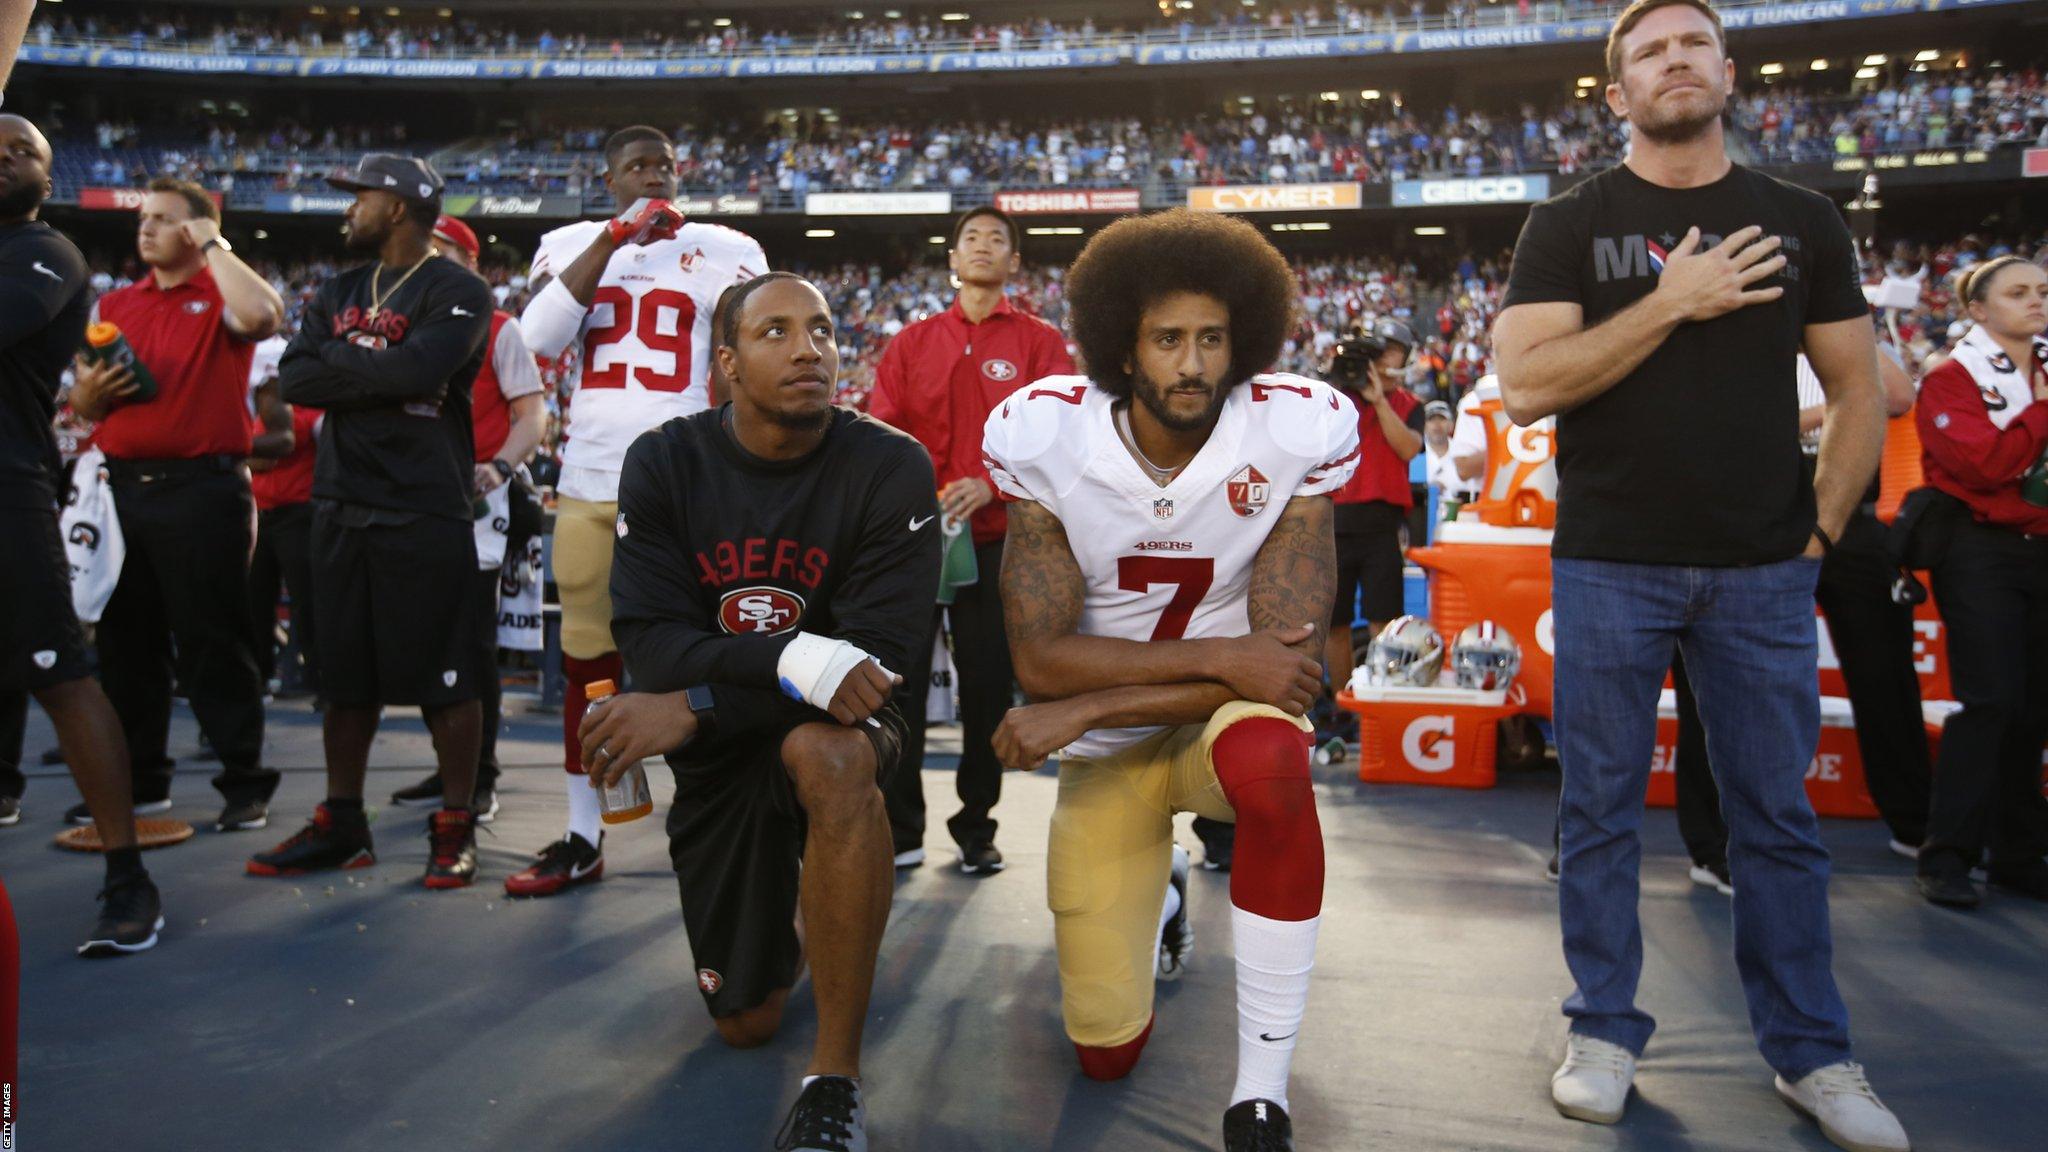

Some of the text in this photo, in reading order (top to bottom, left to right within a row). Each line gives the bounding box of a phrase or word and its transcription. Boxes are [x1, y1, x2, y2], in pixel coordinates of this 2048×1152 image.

[481, 197, 542, 214] FanDuel
[998, 194, 1089, 211] TOSHIBA
[1212, 187, 1335, 208] CYMER
[1421, 179, 1526, 203] GEICO
[581, 286, 696, 393] 29
[1134, 541, 1193, 550] 49ERS
[696, 538, 829, 589] 49ERS
[1117, 556, 1214, 641] 7
[738, 596, 789, 632] SF
[1402, 715, 1455, 772] G
